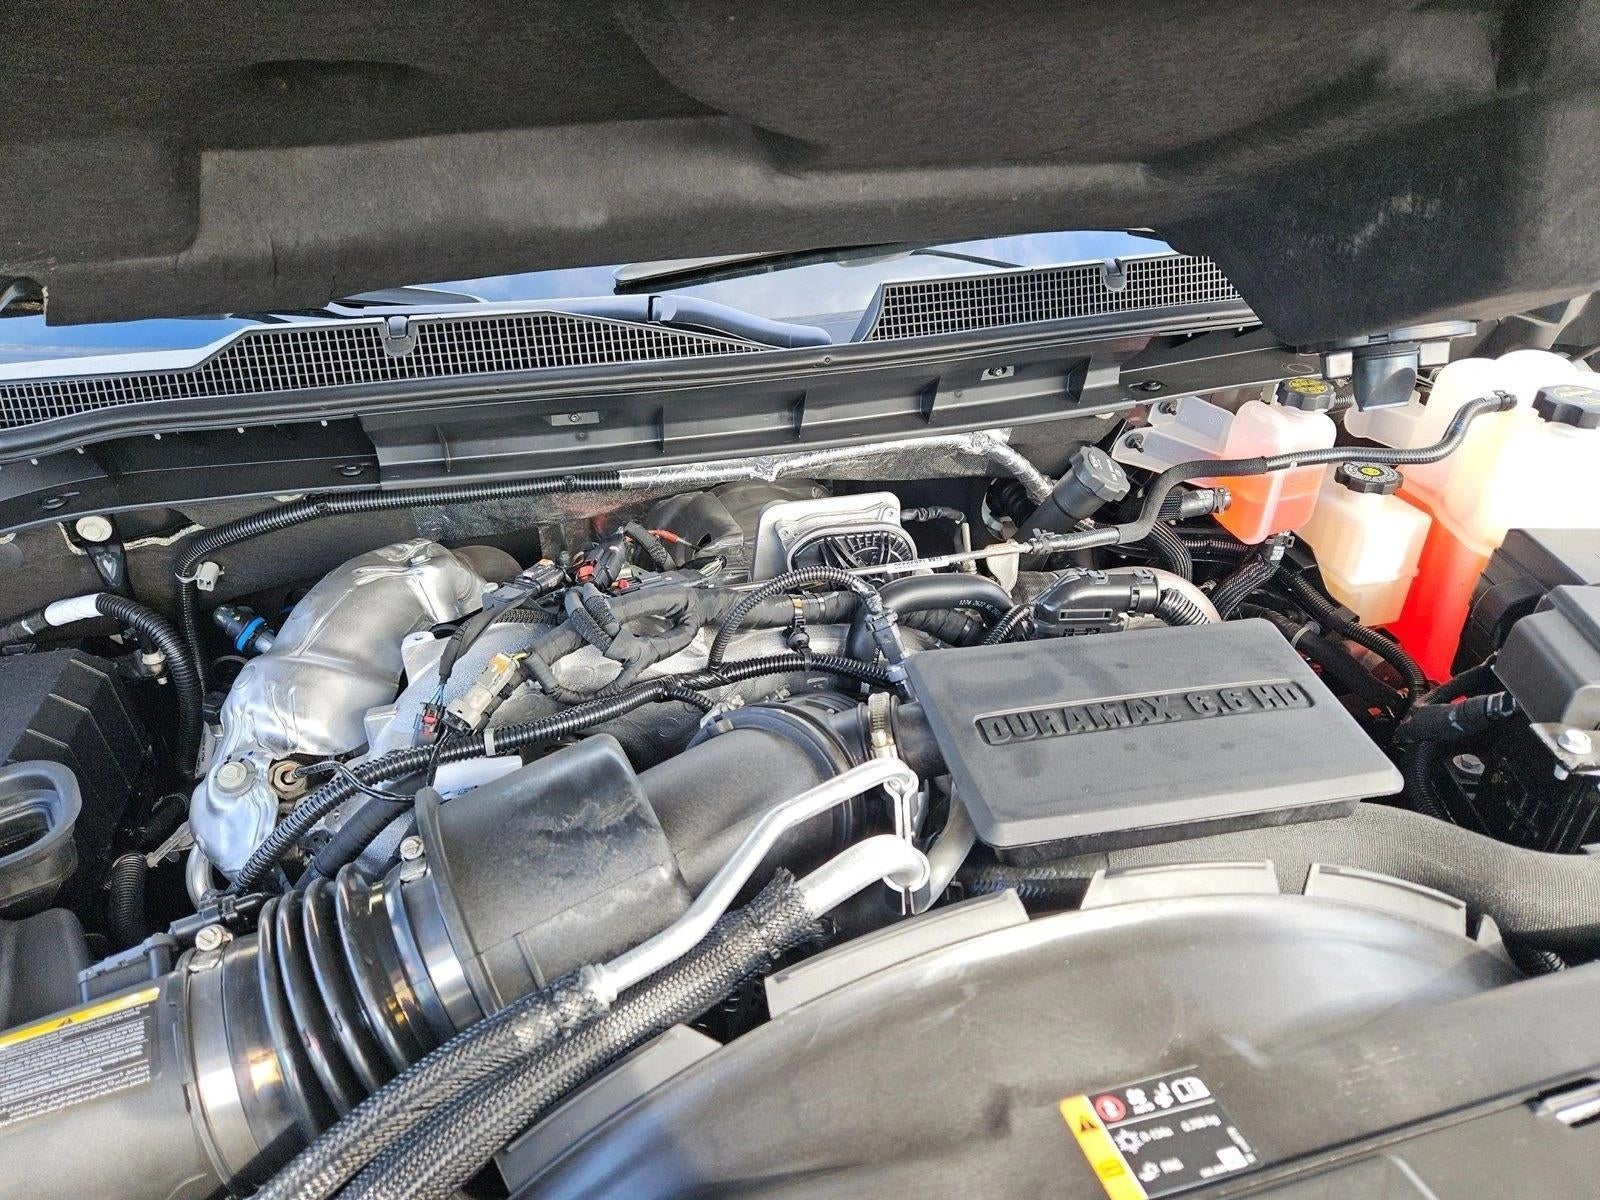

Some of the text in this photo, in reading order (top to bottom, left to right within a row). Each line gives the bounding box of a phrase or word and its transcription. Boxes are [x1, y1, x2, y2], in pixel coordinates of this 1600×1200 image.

[979, 682, 1303, 745] DURAMAX 6.6 HD
